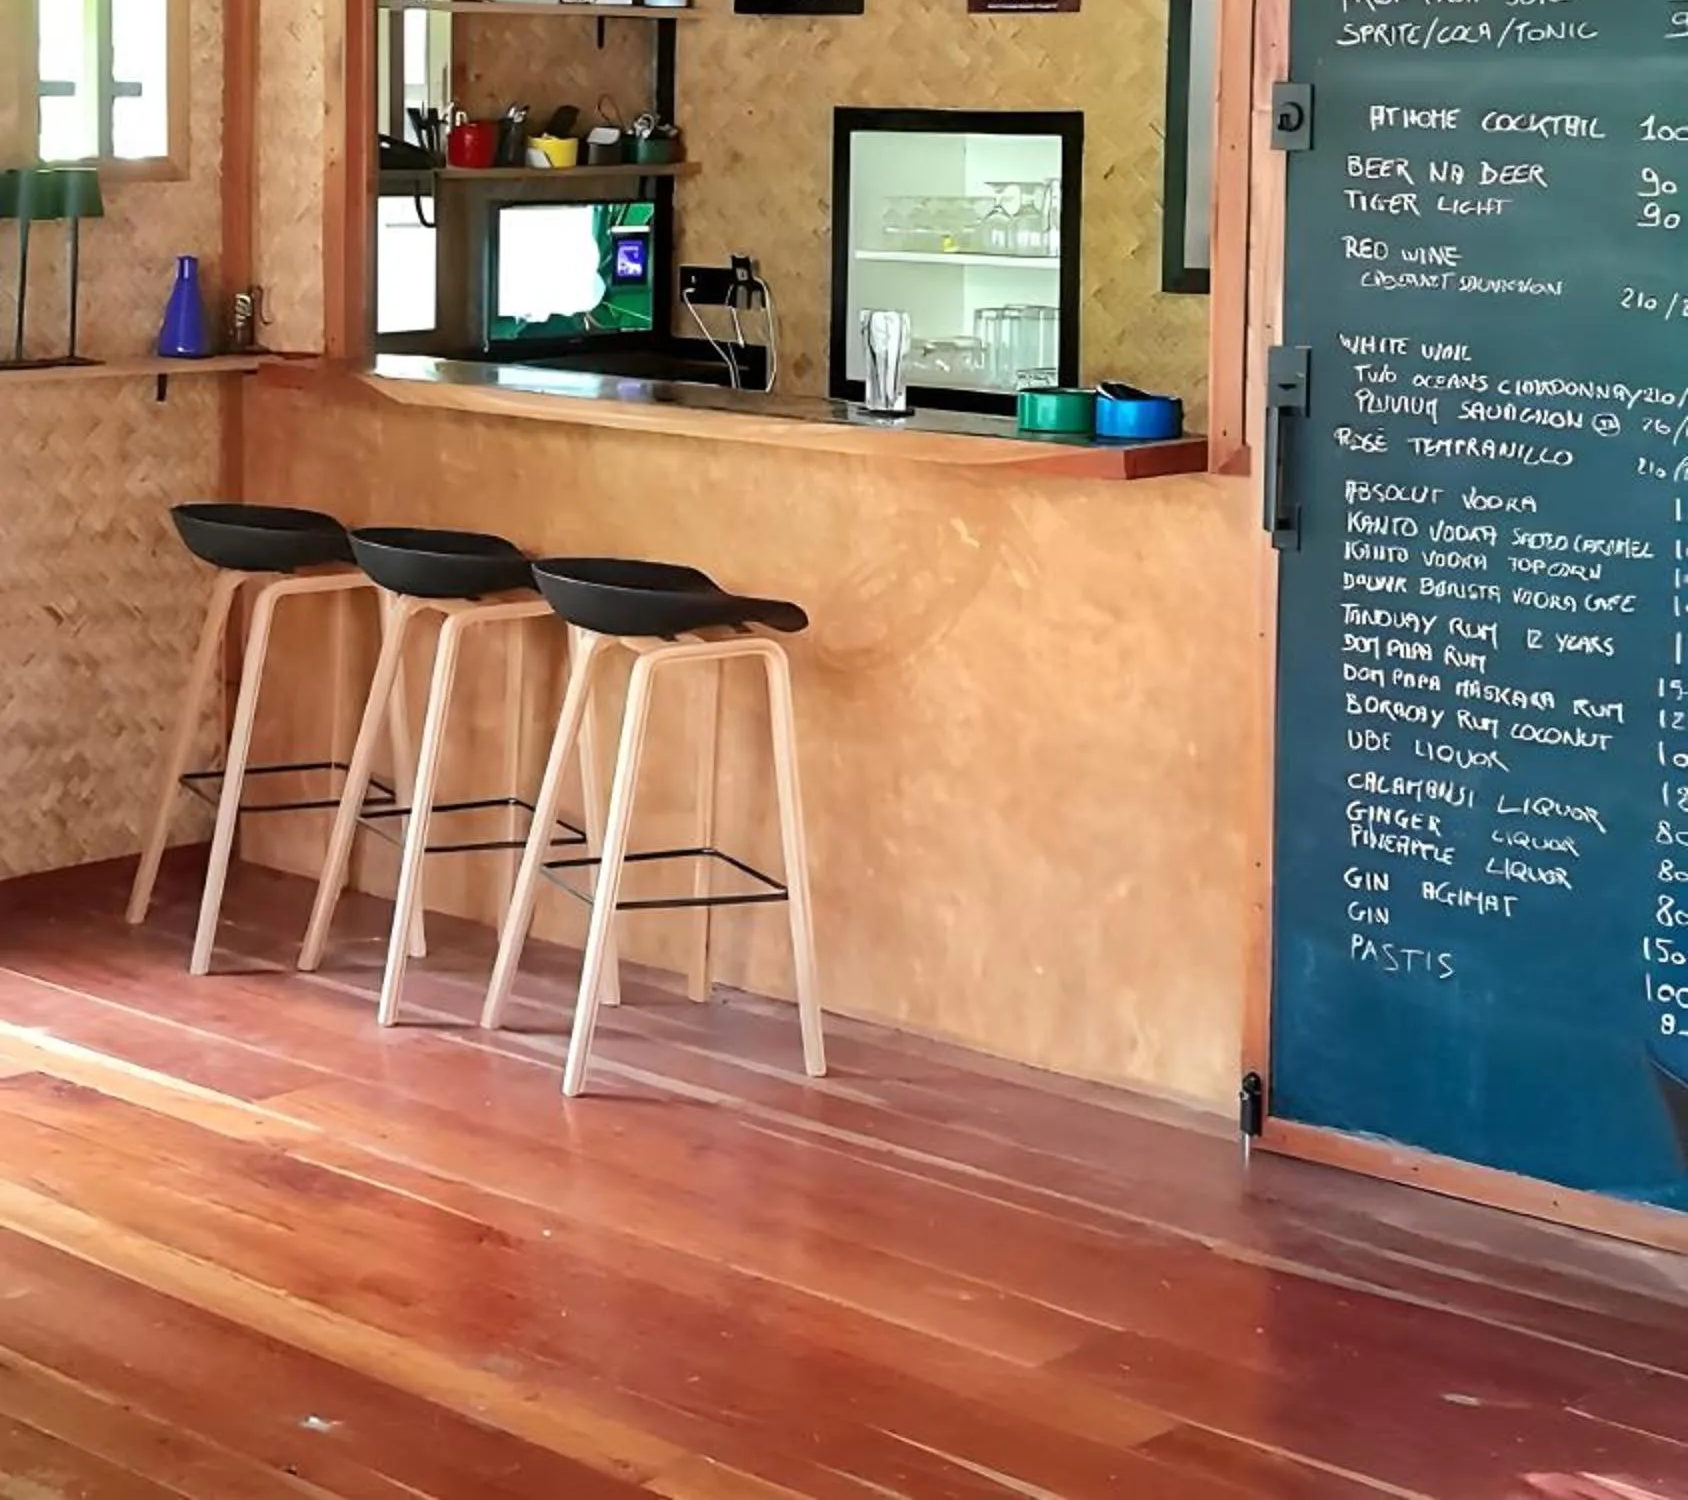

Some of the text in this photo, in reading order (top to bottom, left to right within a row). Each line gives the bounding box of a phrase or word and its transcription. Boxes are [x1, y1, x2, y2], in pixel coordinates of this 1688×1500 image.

[1482, 112, 1606, 139] COCKTAIL
[1347, 155, 1414, 186] BEER
[1344, 189, 1421, 217] TIGER
[1437, 197, 1513, 215] LIGHT
[1342, 236, 1463, 267] RED WINE
[1340, 333, 1409, 356] WHITE
[1345, 480, 1444, 504] ABSOLUT
[1462, 486, 1536, 513] VODKA
[1347, 511, 1418, 537] KANTO
[1341, 604, 1438, 635] TANDUAY
[1449, 616, 1498, 649] RUM
[1444, 647, 1486, 673] RUM
[1573, 698, 1625, 724] RUM
[1457, 710, 1499, 738] RUM
[1510, 723, 1613, 752] COCONUT
[1346, 801, 1442, 837] GINGER
[1492, 830, 1580, 857] LIQUOR
[1497, 795, 1607, 834] LIQUOR
[1344, 867, 1389, 891] GIN
[1486, 857, 1572, 889] LIQUOR
[1348, 902, 1389, 925] GIN
[1350, 934, 1456, 979] PASTIS
